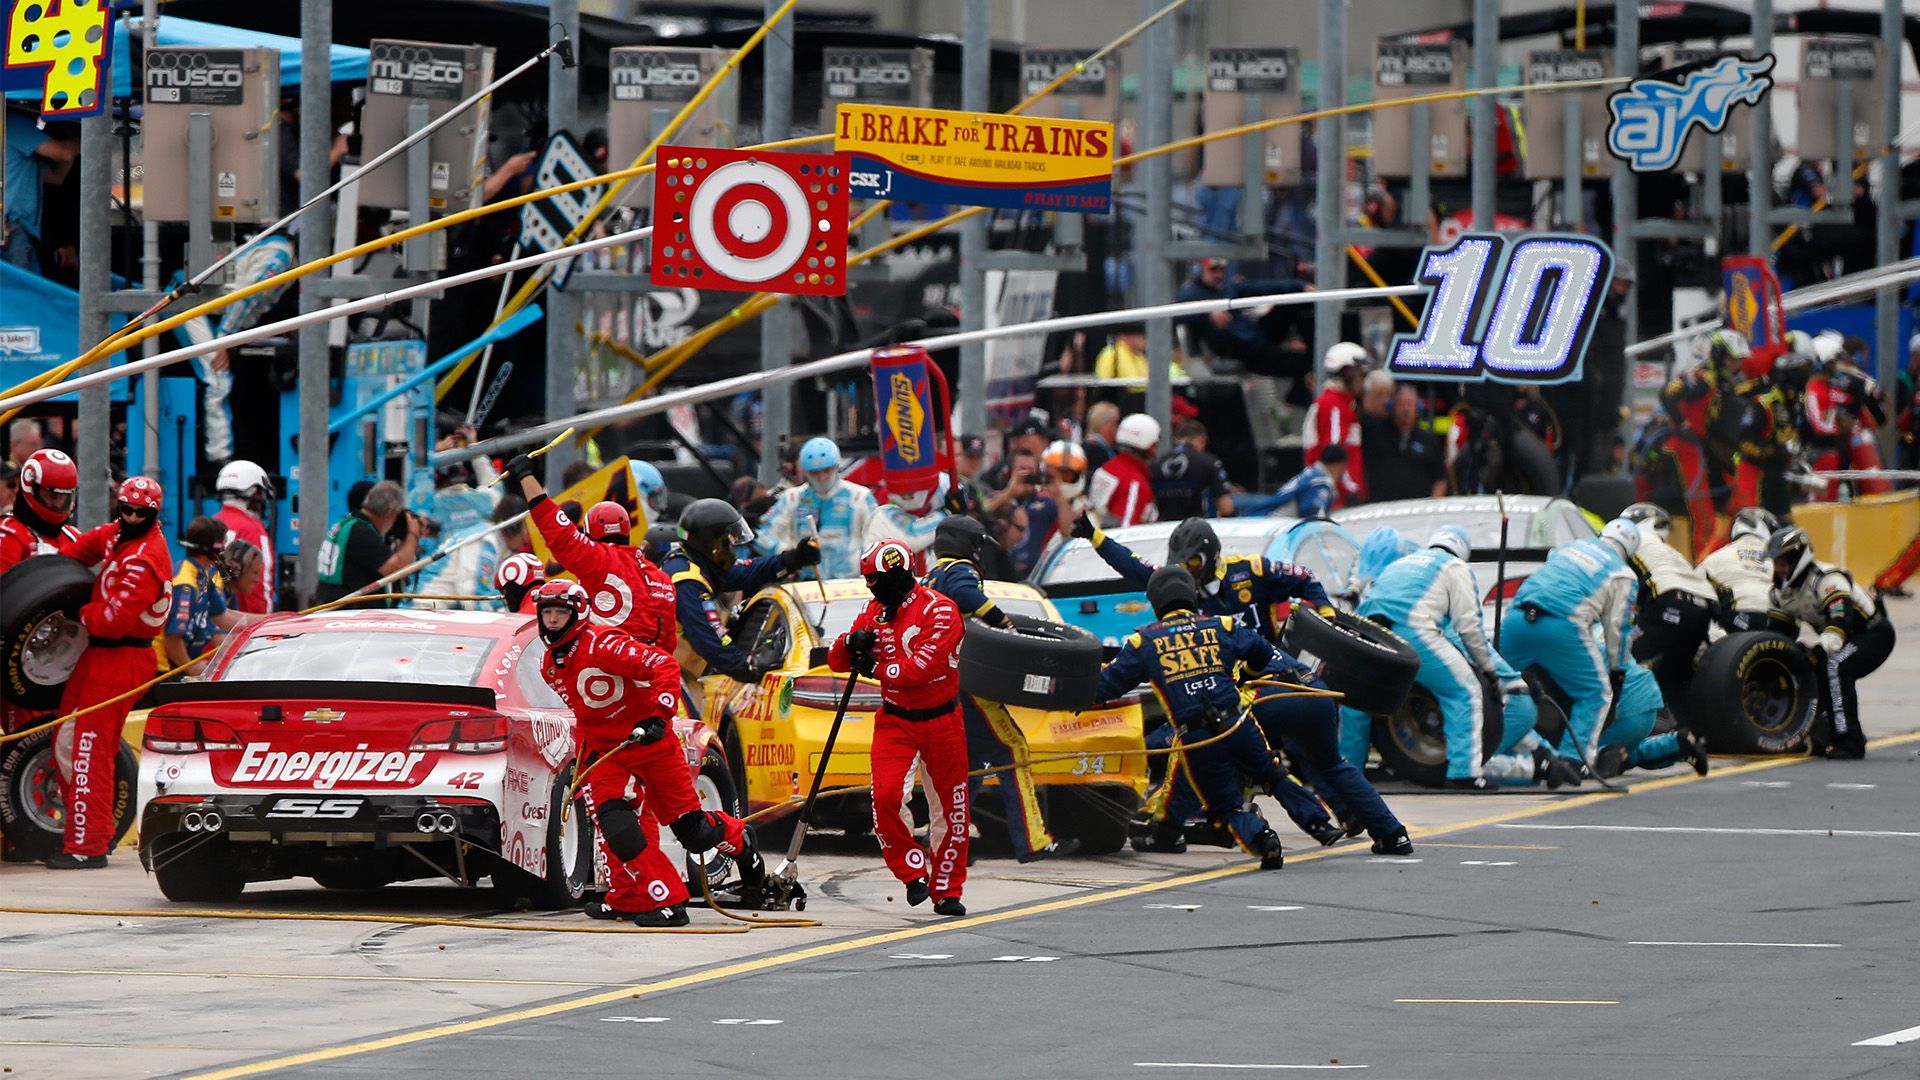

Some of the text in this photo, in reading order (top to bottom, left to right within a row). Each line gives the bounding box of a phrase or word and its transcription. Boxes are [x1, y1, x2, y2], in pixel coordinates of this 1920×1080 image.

[171, 90, 178, 99] 9
[840, 112, 1108, 158] I BRAKE FOR TRAINS
[953, 157, 968, 167] SAFE
[969, 158, 992, 169] AROUND
[994, 159, 1022, 171] RAILROAD
[1066, 195, 1078, 207] IT
[1080, 196, 1107, 208] SAFE
[1395, 239, 1602, 373] 10
[894, 376, 916, 457] SUNOCO
[1153, 631, 1197, 654] PLAY
[1160, 644, 1223, 676] SAFE
[17, 726, 55, 749] TROOP
[5, 749, 23, 771] OUR
[231, 742, 425, 789] Energizer
[747, 744, 795, 767] RAILROAD
[1071, 751, 1105, 775] 34
[74, 731, 98, 845] target.com
[447, 771, 484, 790] 42
[0, 774, 15, 823] SUPPORT
[265, 798, 365, 819] SS
[522, 802, 547, 821] Crest
[936, 782, 967, 891] target.com
